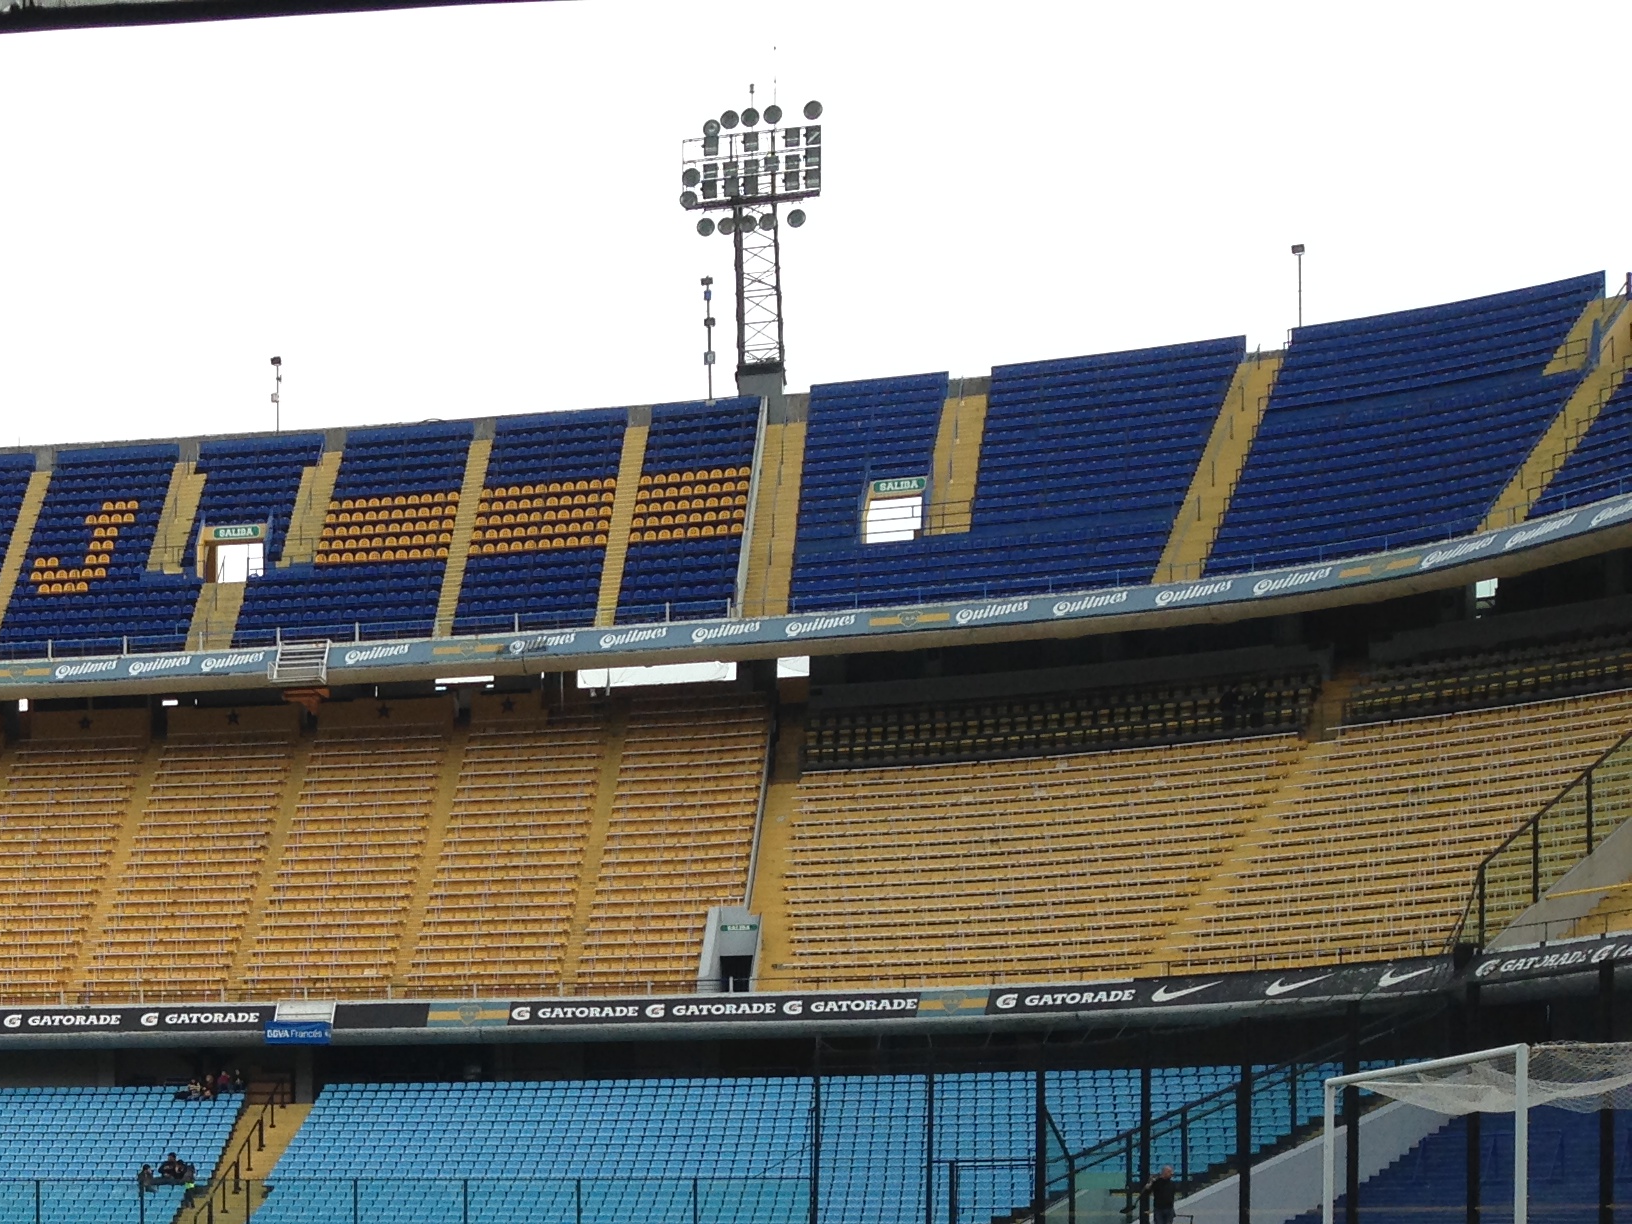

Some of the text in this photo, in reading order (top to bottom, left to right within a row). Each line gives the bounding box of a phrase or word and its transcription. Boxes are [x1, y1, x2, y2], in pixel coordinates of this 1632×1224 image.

[879, 480, 918, 491] SALIDA
[219, 528, 253, 538] SALIDA
[1420, 533, 1500, 569] Quilmes
[1253, 566, 1333, 595] Quilmes
[1052, 590, 1128, 616] Quilmes
[1155, 580, 1233, 607] Quilmes
[955, 600, 1029, 625] Quilmes
[692, 621, 761, 643] Quilmes
[785, 615, 856, 637] Quilmes
[599, 627, 668, 649] Quilmes
[201, 652, 265, 672] Quilmes
[345, 643, 411, 664] Quilmes
[55, 660, 118, 679] Quilmes
[129, 656, 192, 675] Quilmes
[810, 998, 919, 1012] GATORADE
[1024, 989, 1137, 1007] GATORADE
[165, 1012, 260, 1024] GATORADE
[537, 1005, 640, 1019] GATORADE
[672, 1002, 777, 1016] GATORADE
[27, 1014, 122, 1027] GATORADE
